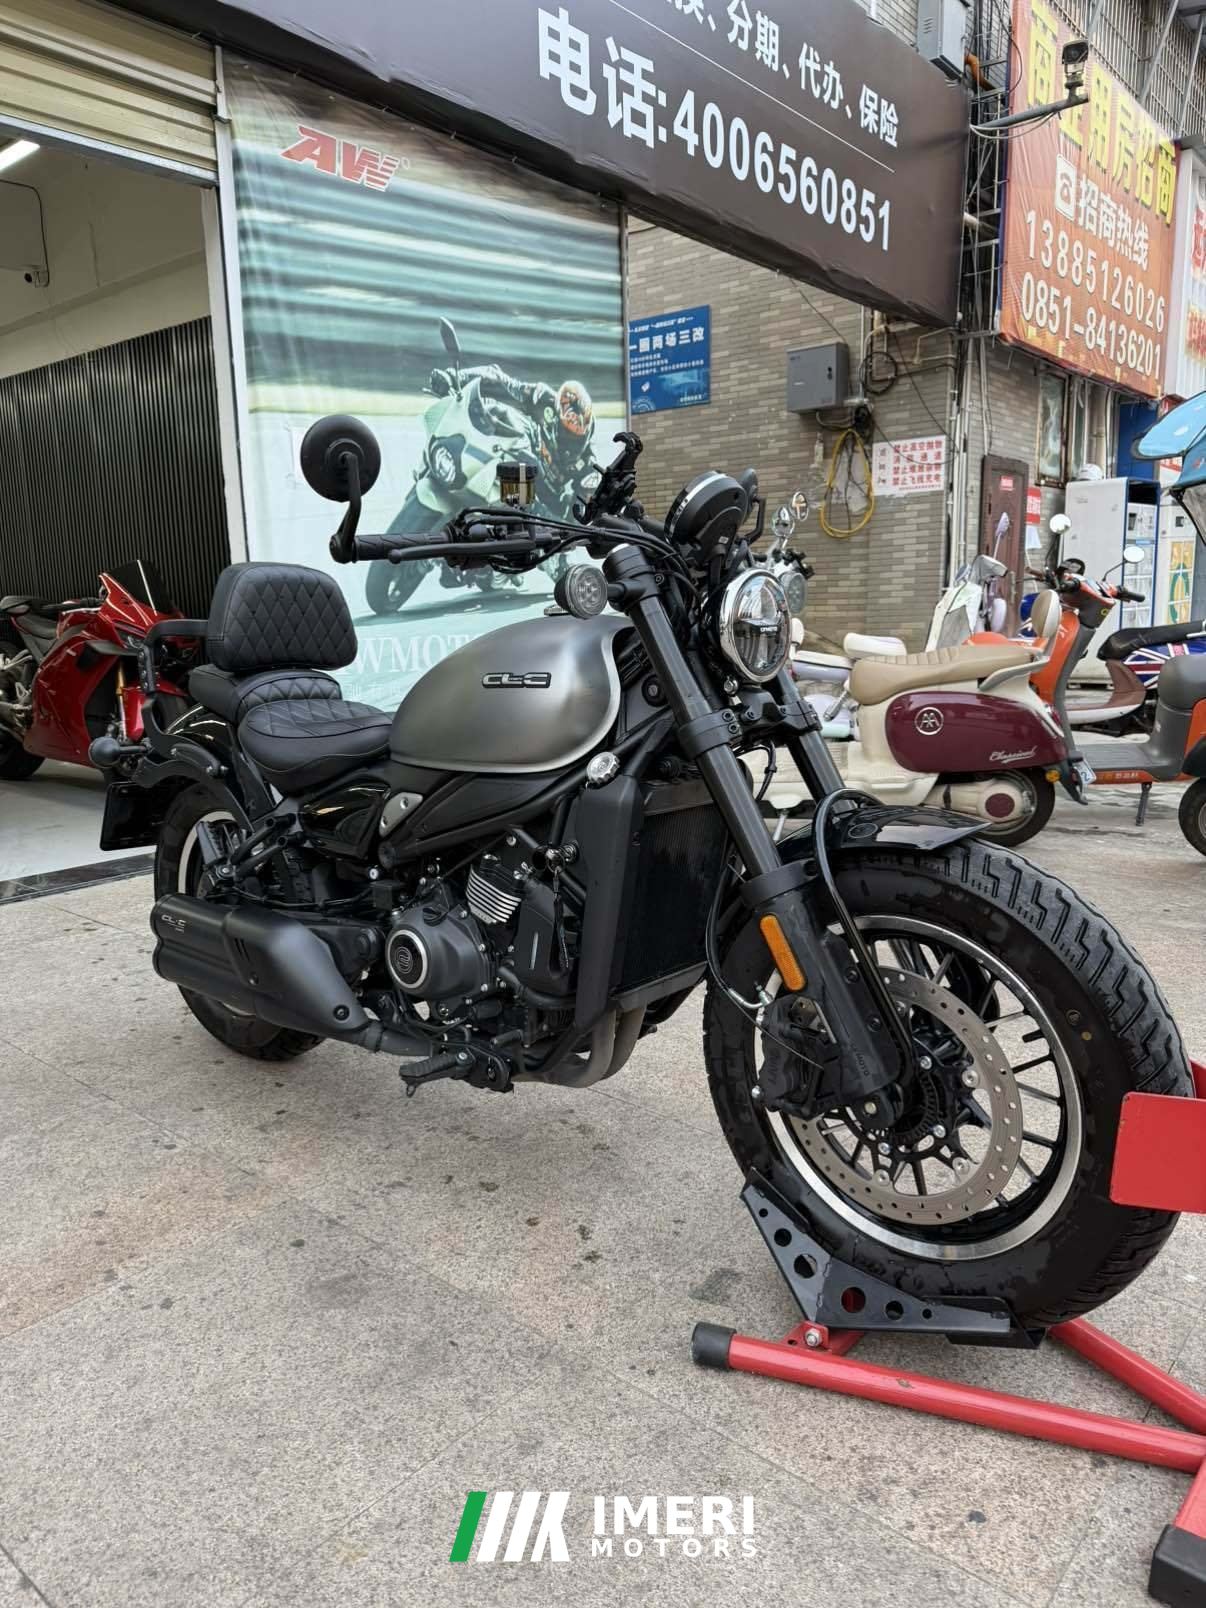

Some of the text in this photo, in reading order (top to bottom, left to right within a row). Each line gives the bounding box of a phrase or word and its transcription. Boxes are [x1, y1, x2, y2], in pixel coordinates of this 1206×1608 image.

[537, 7, 892, 251] 电话:4006560851
[1026, 209, 1165, 333] 13885126026
[1079, 173, 1149, 271] 招商热线
[1021, 271, 1161, 380] 0851-84136201
